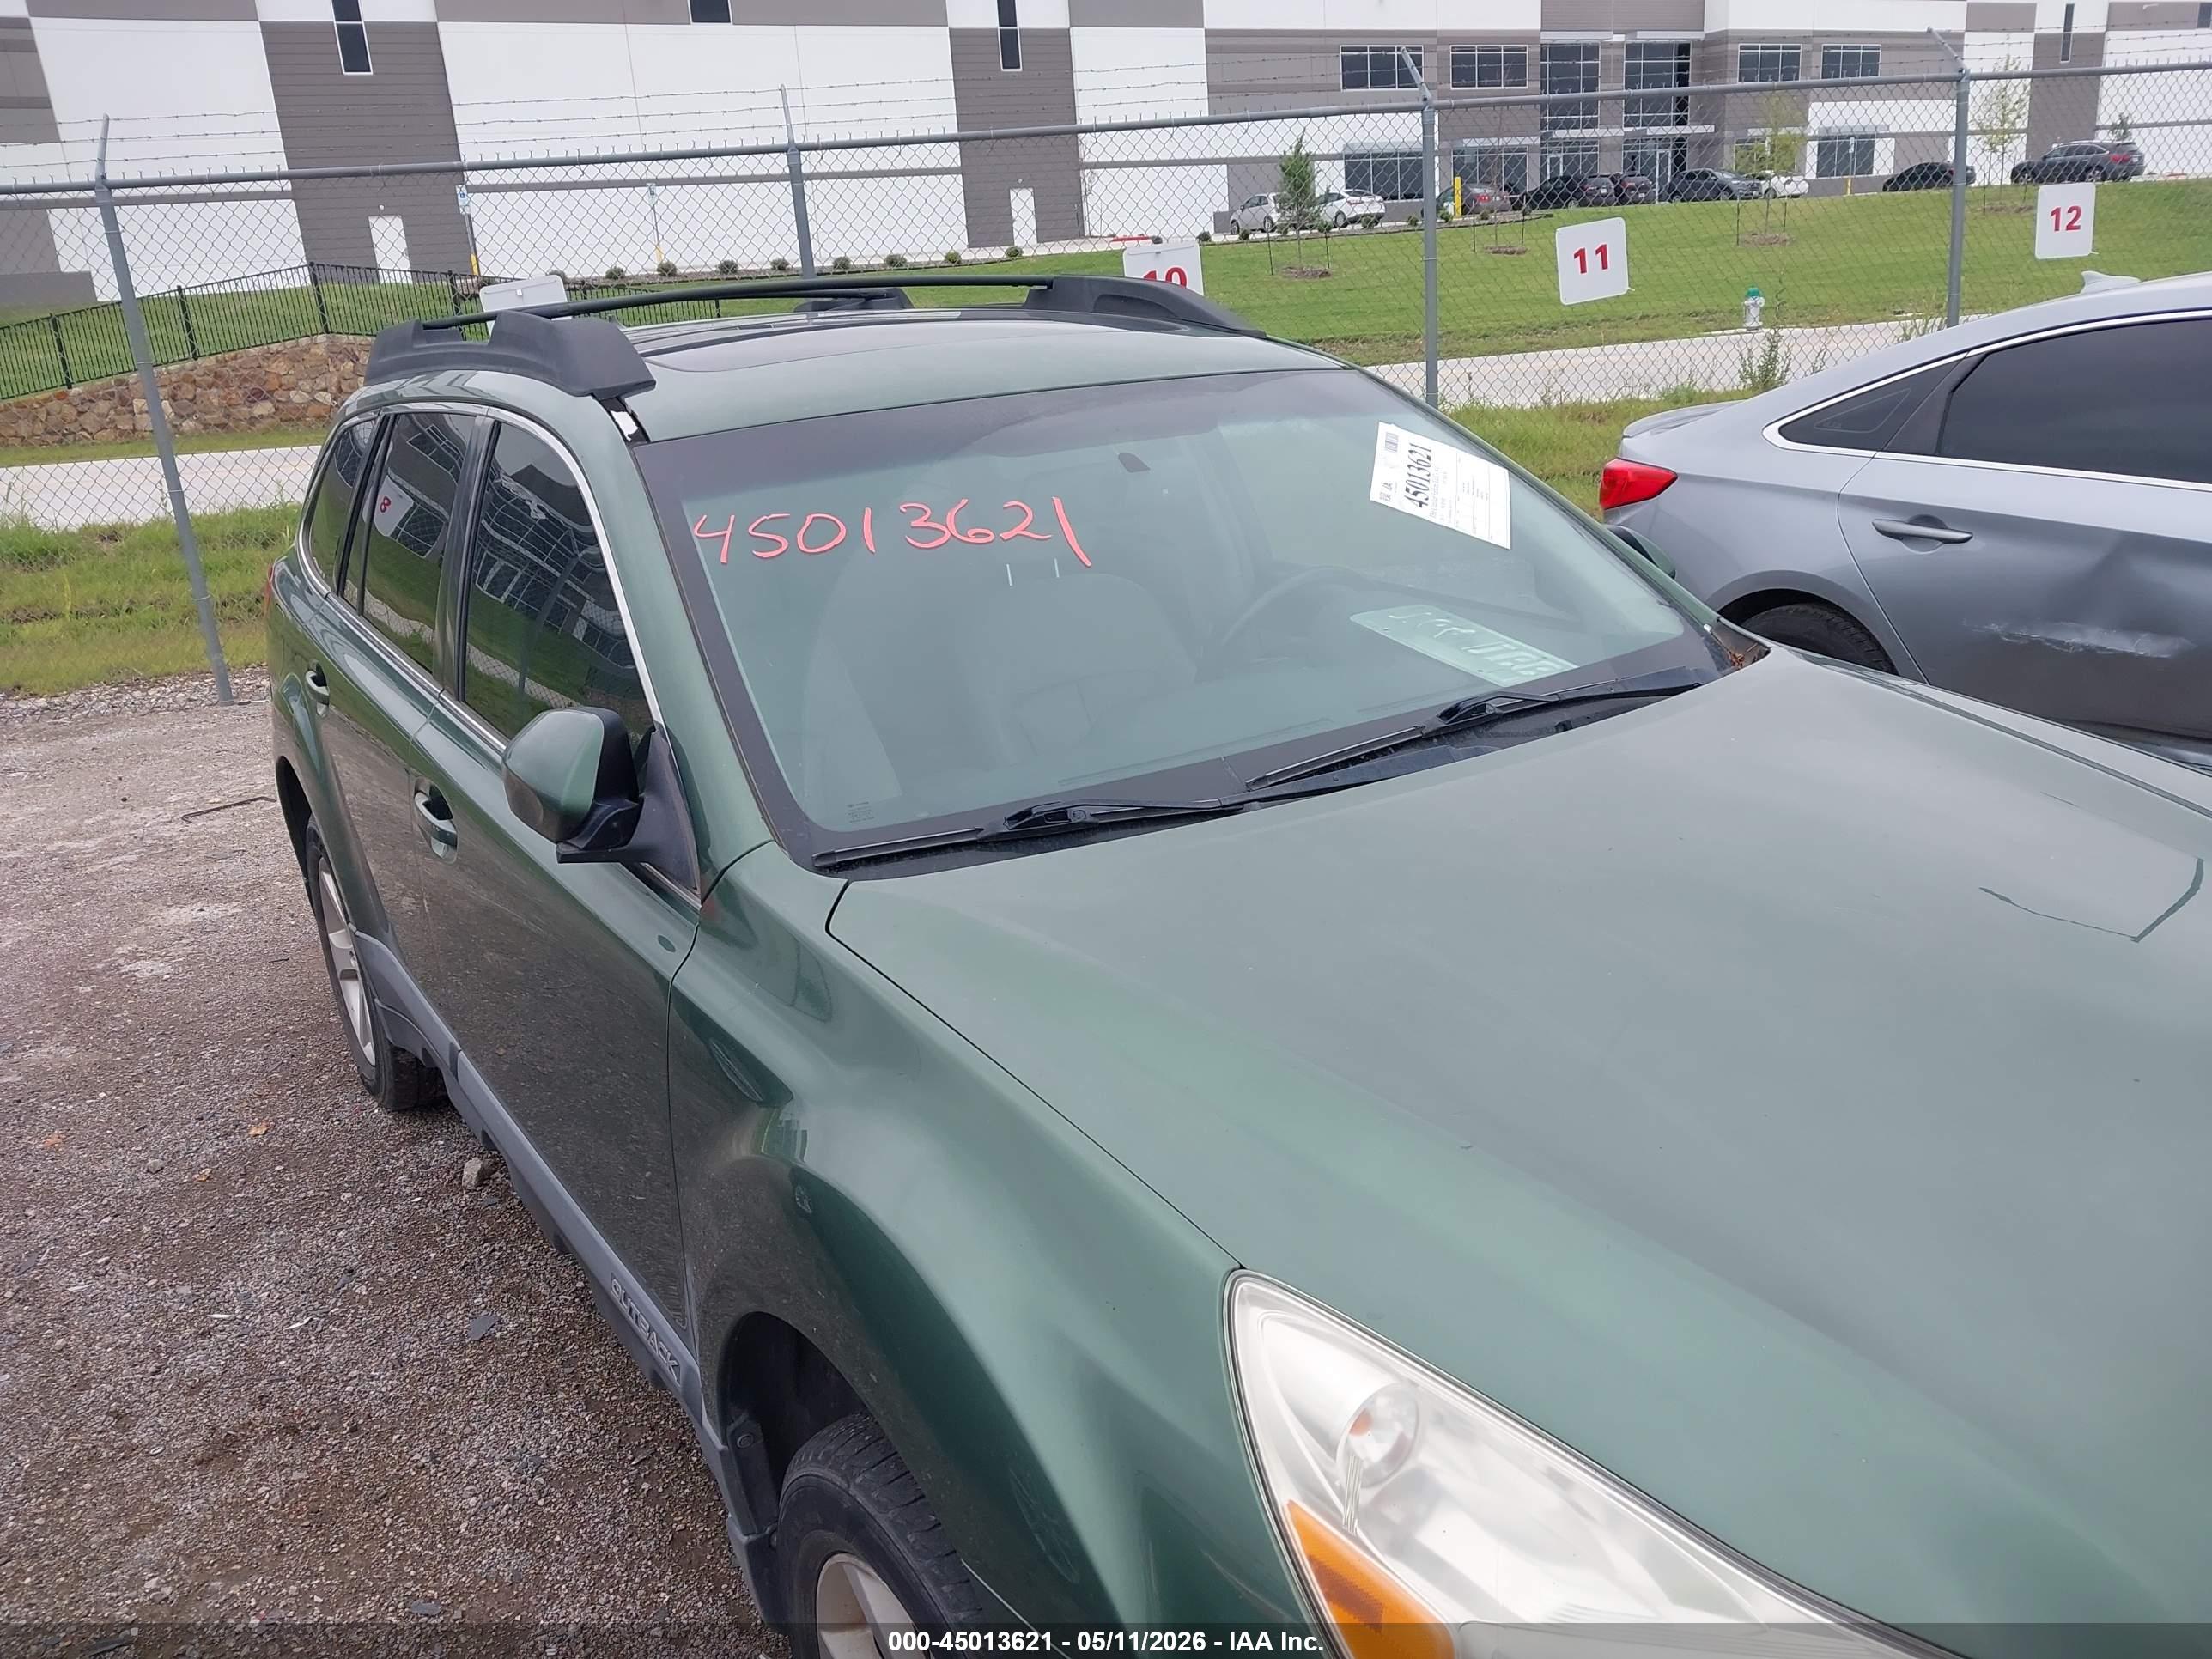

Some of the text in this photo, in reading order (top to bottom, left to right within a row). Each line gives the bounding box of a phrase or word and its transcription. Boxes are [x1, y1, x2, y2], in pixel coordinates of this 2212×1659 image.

[2051, 206, 2081, 231] 12
[1574, 244, 1608, 274] 11
[1403, 442, 1432, 508] 45013621
[694, 496, 1091, 567] 45013621
[611, 1279, 680, 1384] OUTBACK
